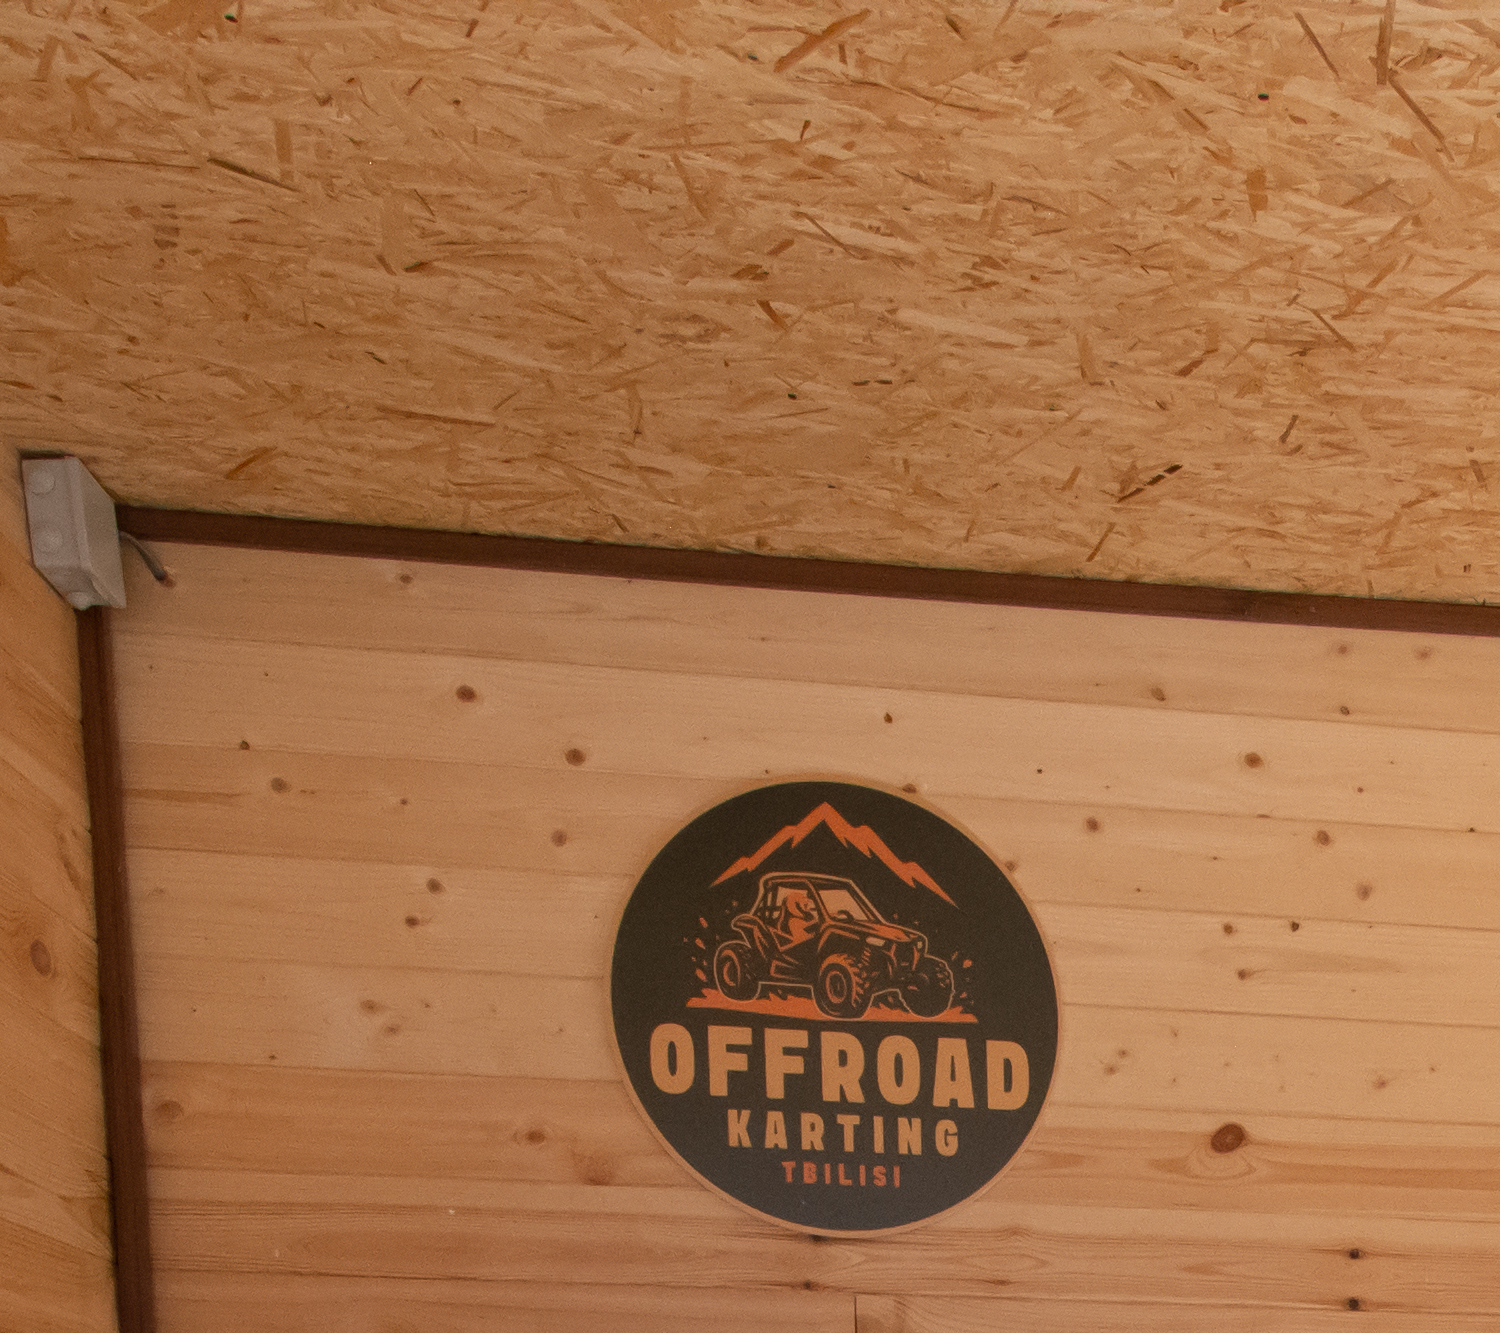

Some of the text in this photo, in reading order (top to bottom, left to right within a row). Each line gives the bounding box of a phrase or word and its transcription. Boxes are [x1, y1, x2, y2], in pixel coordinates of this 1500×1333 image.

[649, 1022, 1031, 1111] OFFROAD
[726, 1109, 959, 1157] KARTING
[781, 1160, 901, 1188] TBILISI
